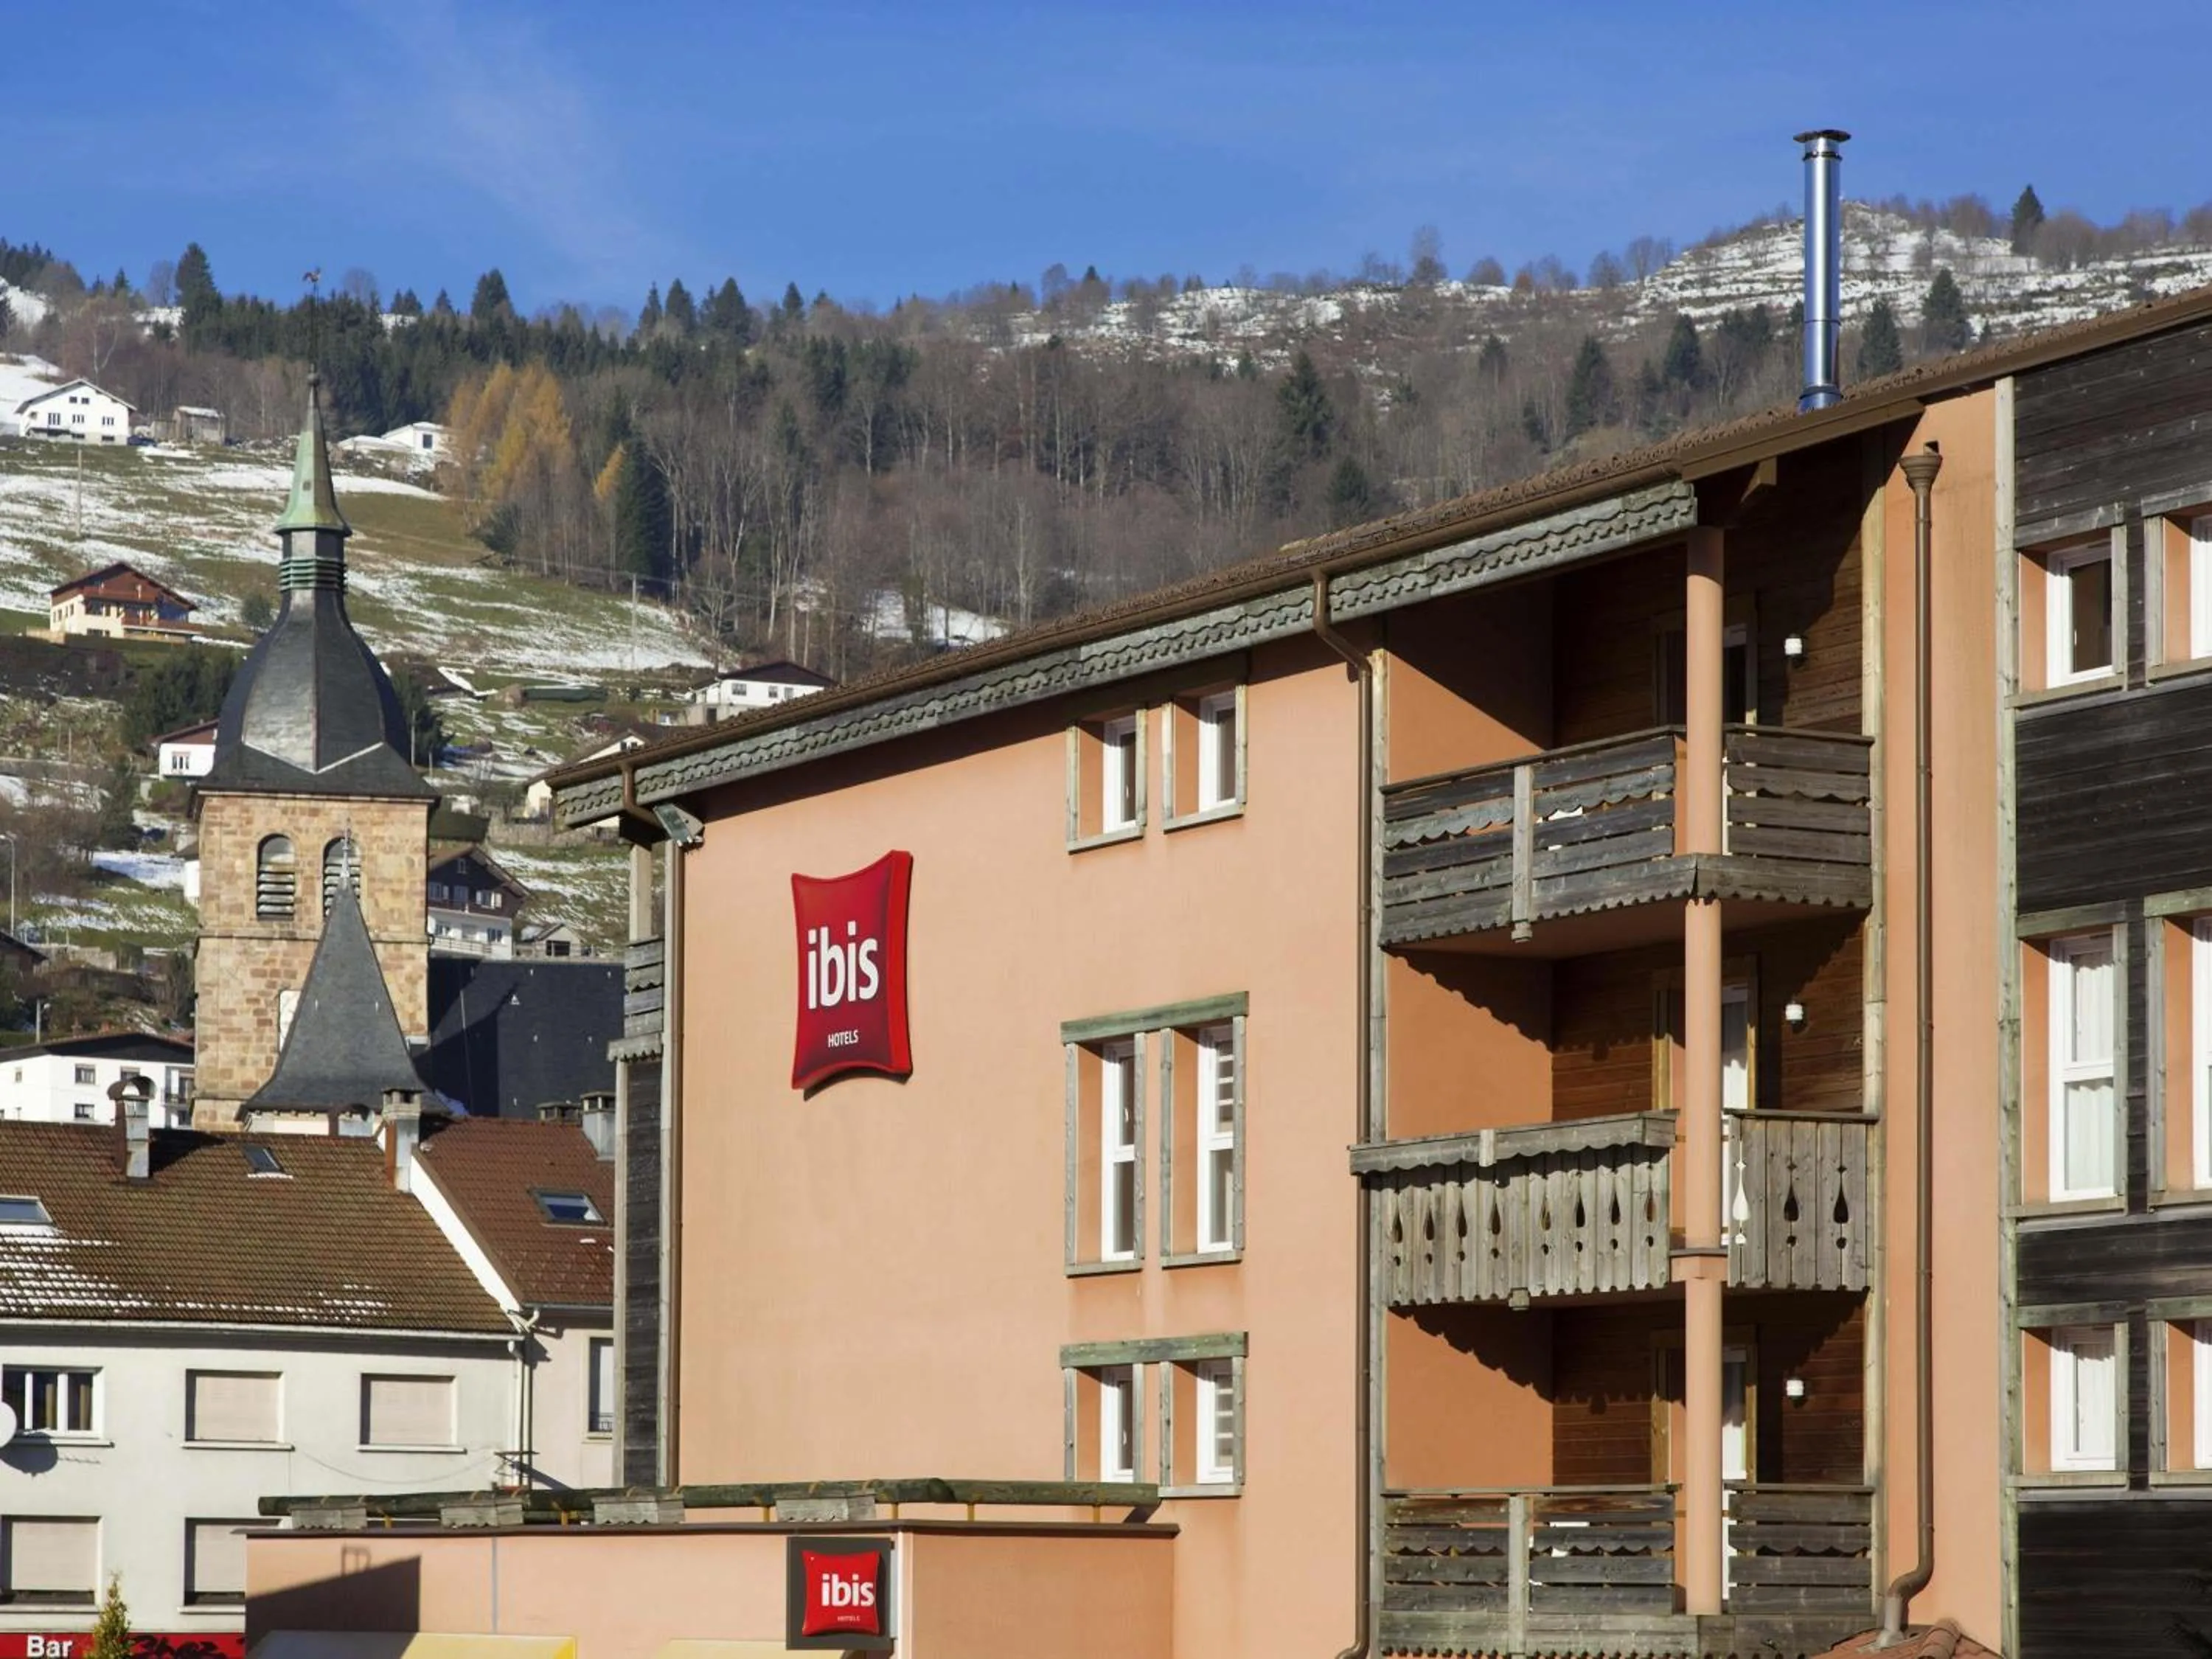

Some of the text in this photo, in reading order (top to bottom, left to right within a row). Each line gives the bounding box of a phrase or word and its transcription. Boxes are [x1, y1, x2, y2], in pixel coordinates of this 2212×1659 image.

[808, 920, 879, 1009] ibis
[828, 1029, 859, 1048] HOTELS
[821, 1573, 875, 1607] ibis
[27, 1635, 72, 1658] Bar
